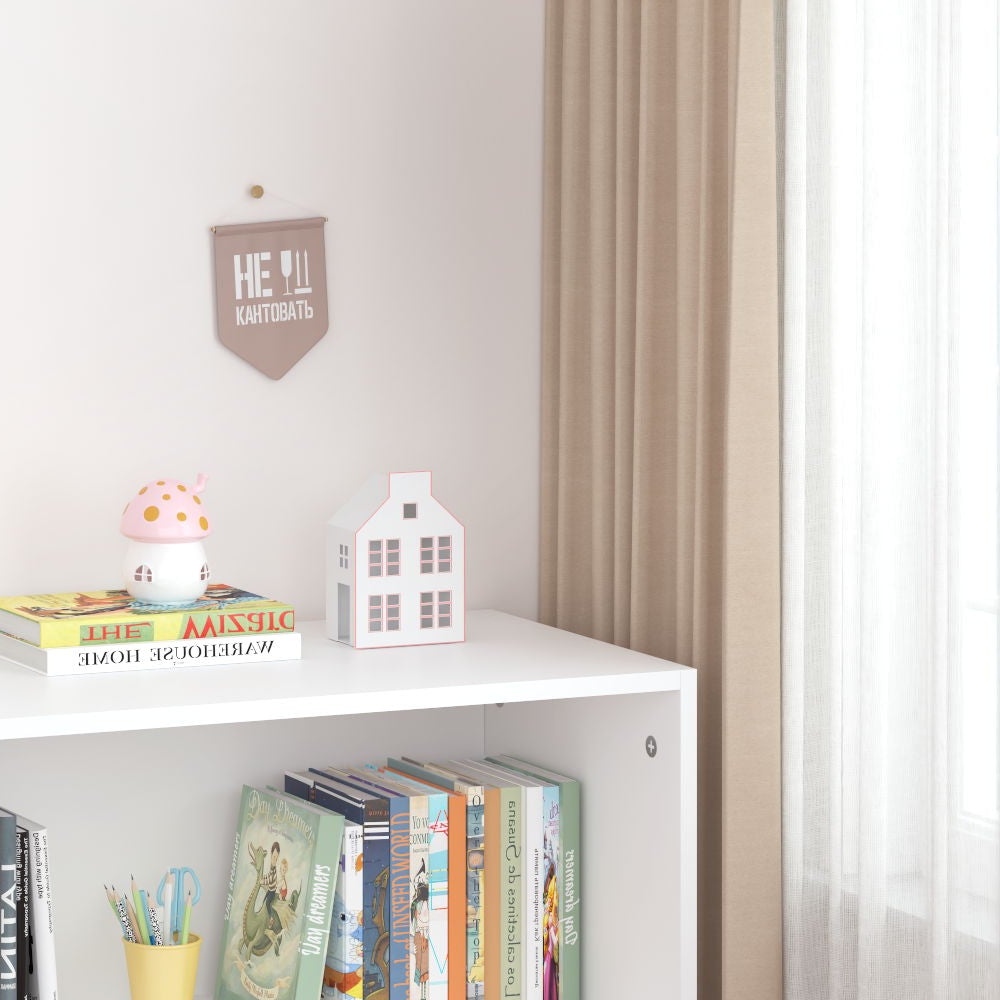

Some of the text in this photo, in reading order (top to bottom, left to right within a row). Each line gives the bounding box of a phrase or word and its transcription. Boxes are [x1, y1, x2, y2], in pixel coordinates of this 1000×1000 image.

[233, 252, 273, 300] НЕ
[236, 299, 314, 326] КАНТОВАТЬ
[308, 864, 331, 925] dreamers
[472, 794, 482, 965] Over the Top
